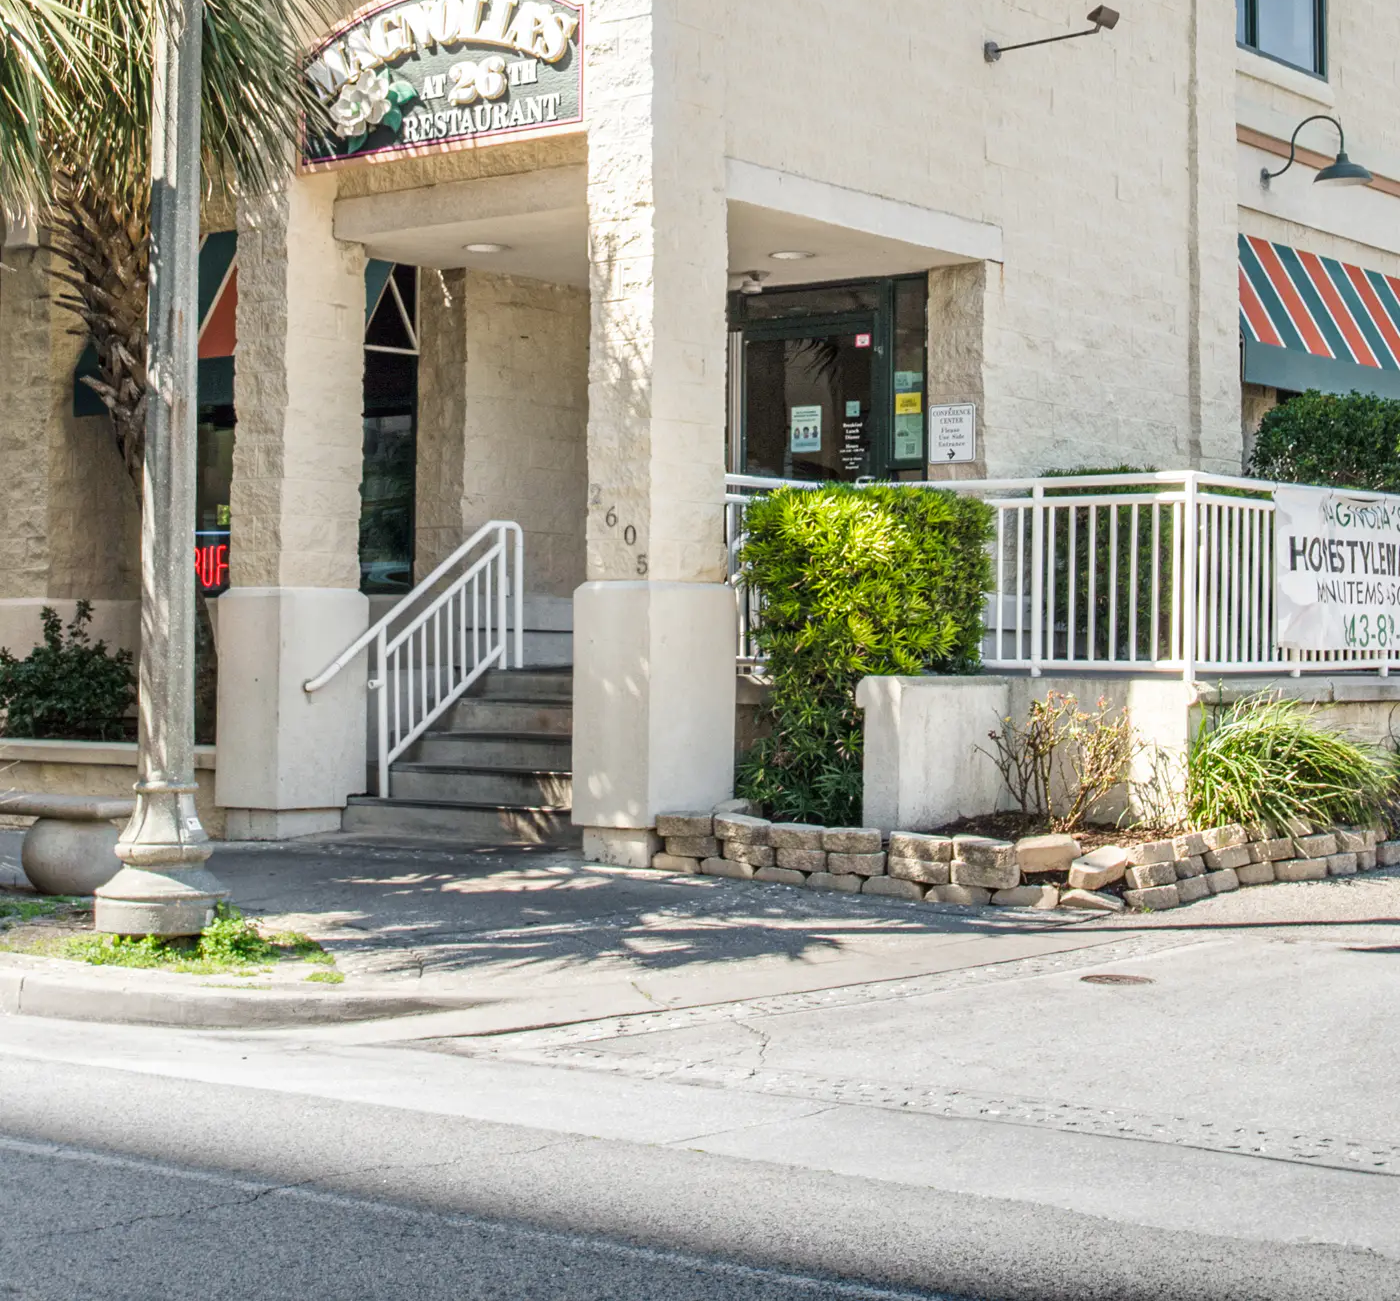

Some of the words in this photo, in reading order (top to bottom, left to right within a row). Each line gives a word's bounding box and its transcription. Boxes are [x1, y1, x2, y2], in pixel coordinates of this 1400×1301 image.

[421, 74, 449, 101] AT
[403, 93, 561, 143] RESTAURANT
[933, 409, 971, 417] CONFERENCE
